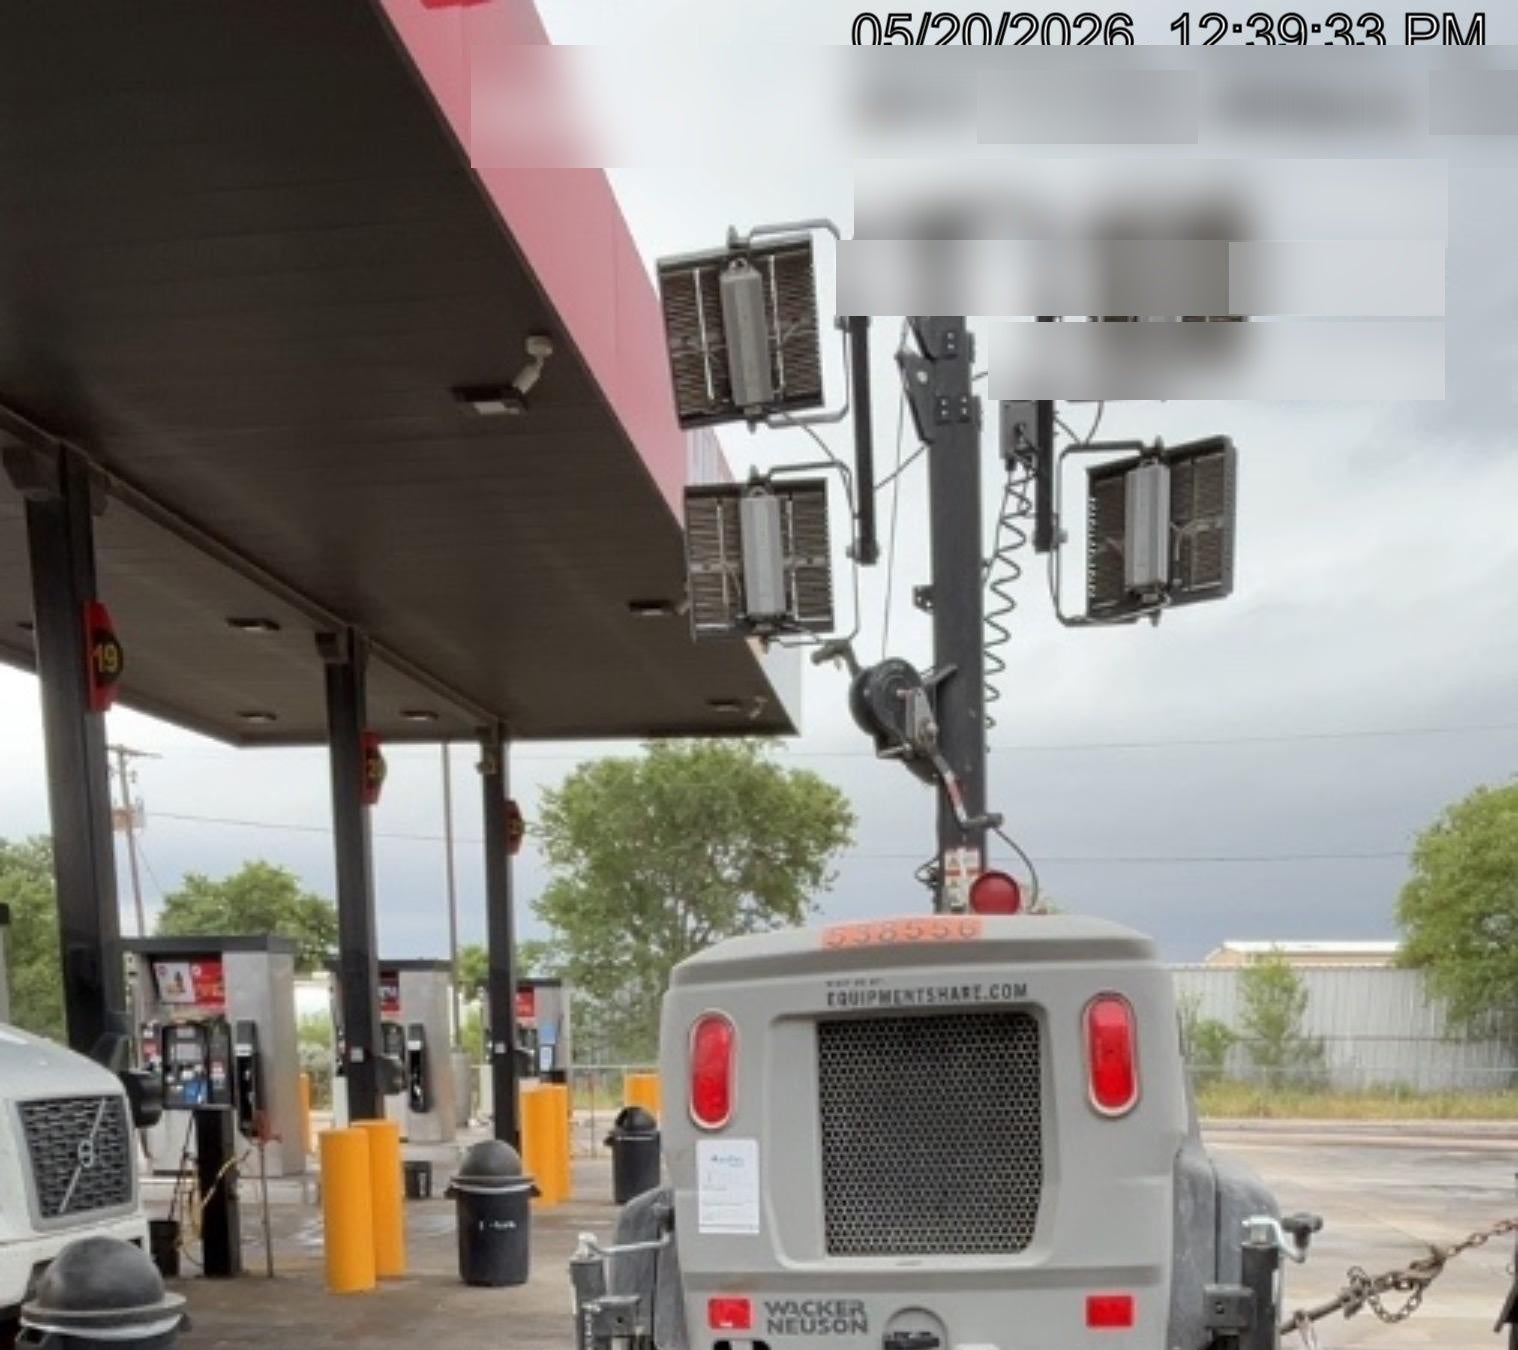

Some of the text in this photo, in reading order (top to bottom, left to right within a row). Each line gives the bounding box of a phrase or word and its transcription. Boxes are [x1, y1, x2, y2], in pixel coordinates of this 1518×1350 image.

[94, 643, 118, 673] 19
[826, 983, 1027, 1007] EQUIPMENTSHARE.COM
[764, 1299, 866, 1318] WACKER
[767, 1318, 868, 1335] NEUSON
